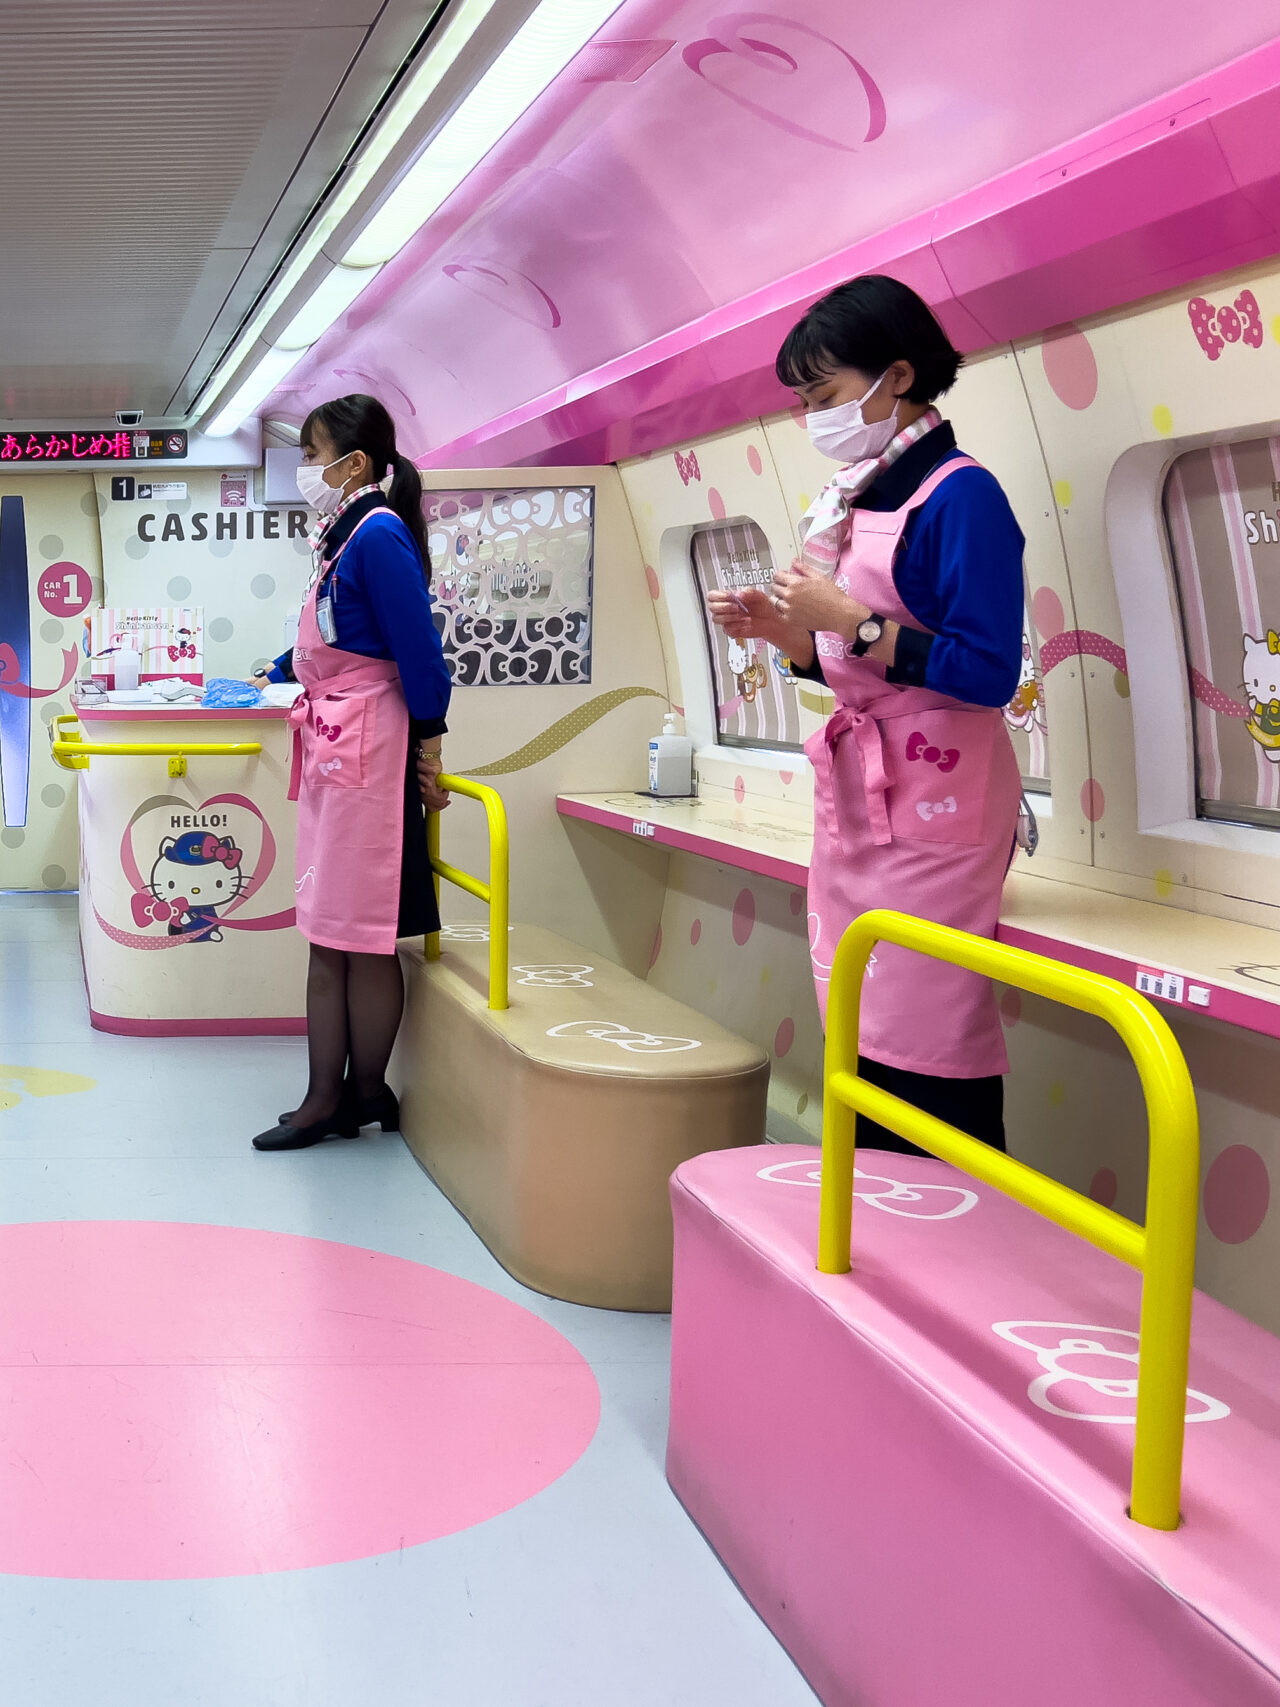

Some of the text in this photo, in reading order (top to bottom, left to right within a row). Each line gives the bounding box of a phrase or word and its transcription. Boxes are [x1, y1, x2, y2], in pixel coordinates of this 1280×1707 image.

[1, 432, 130, 460] あらかじめ指
[118, 479, 127, 498] 1
[137, 510, 308, 542] CASHIER
[43, 581, 61, 590] CAR
[43, 590, 58, 599] No.
[62, 573, 83, 604] 1
[170, 814, 227, 828] HELLO!
